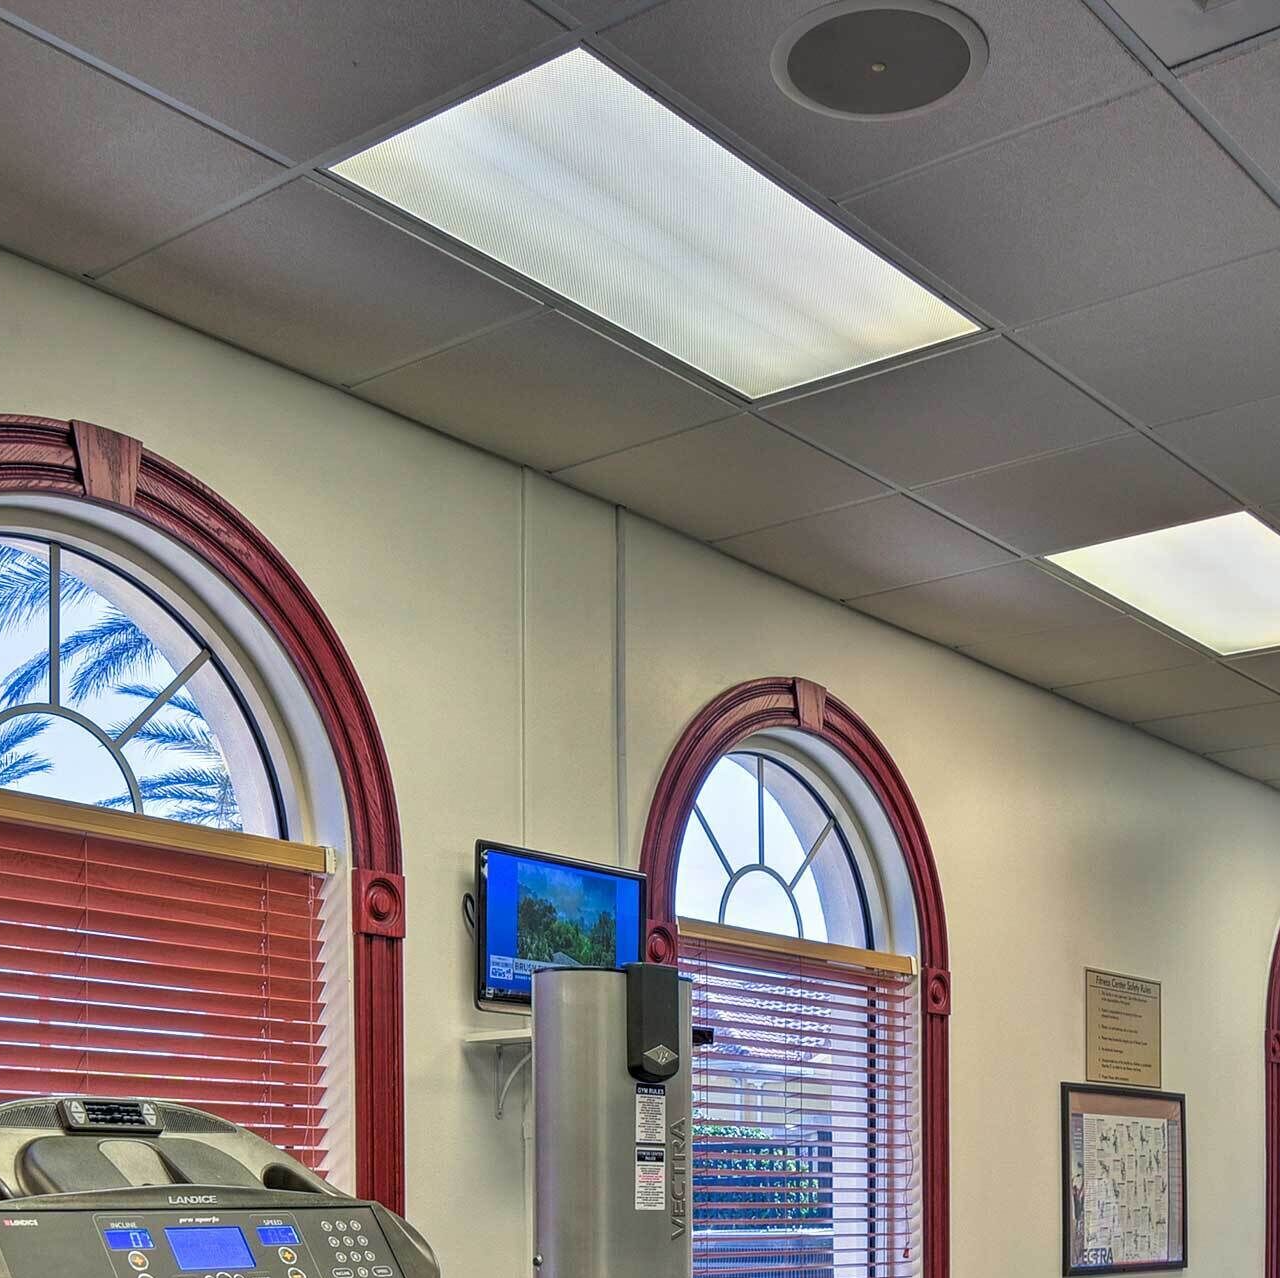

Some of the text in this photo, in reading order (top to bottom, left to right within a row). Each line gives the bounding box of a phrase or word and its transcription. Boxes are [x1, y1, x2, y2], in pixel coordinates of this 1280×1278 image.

[649, 1087, 665, 1095] RULES
[670, 1116, 686, 1241] VECTRA
[168, 1195, 218, 1205] LANDICE
